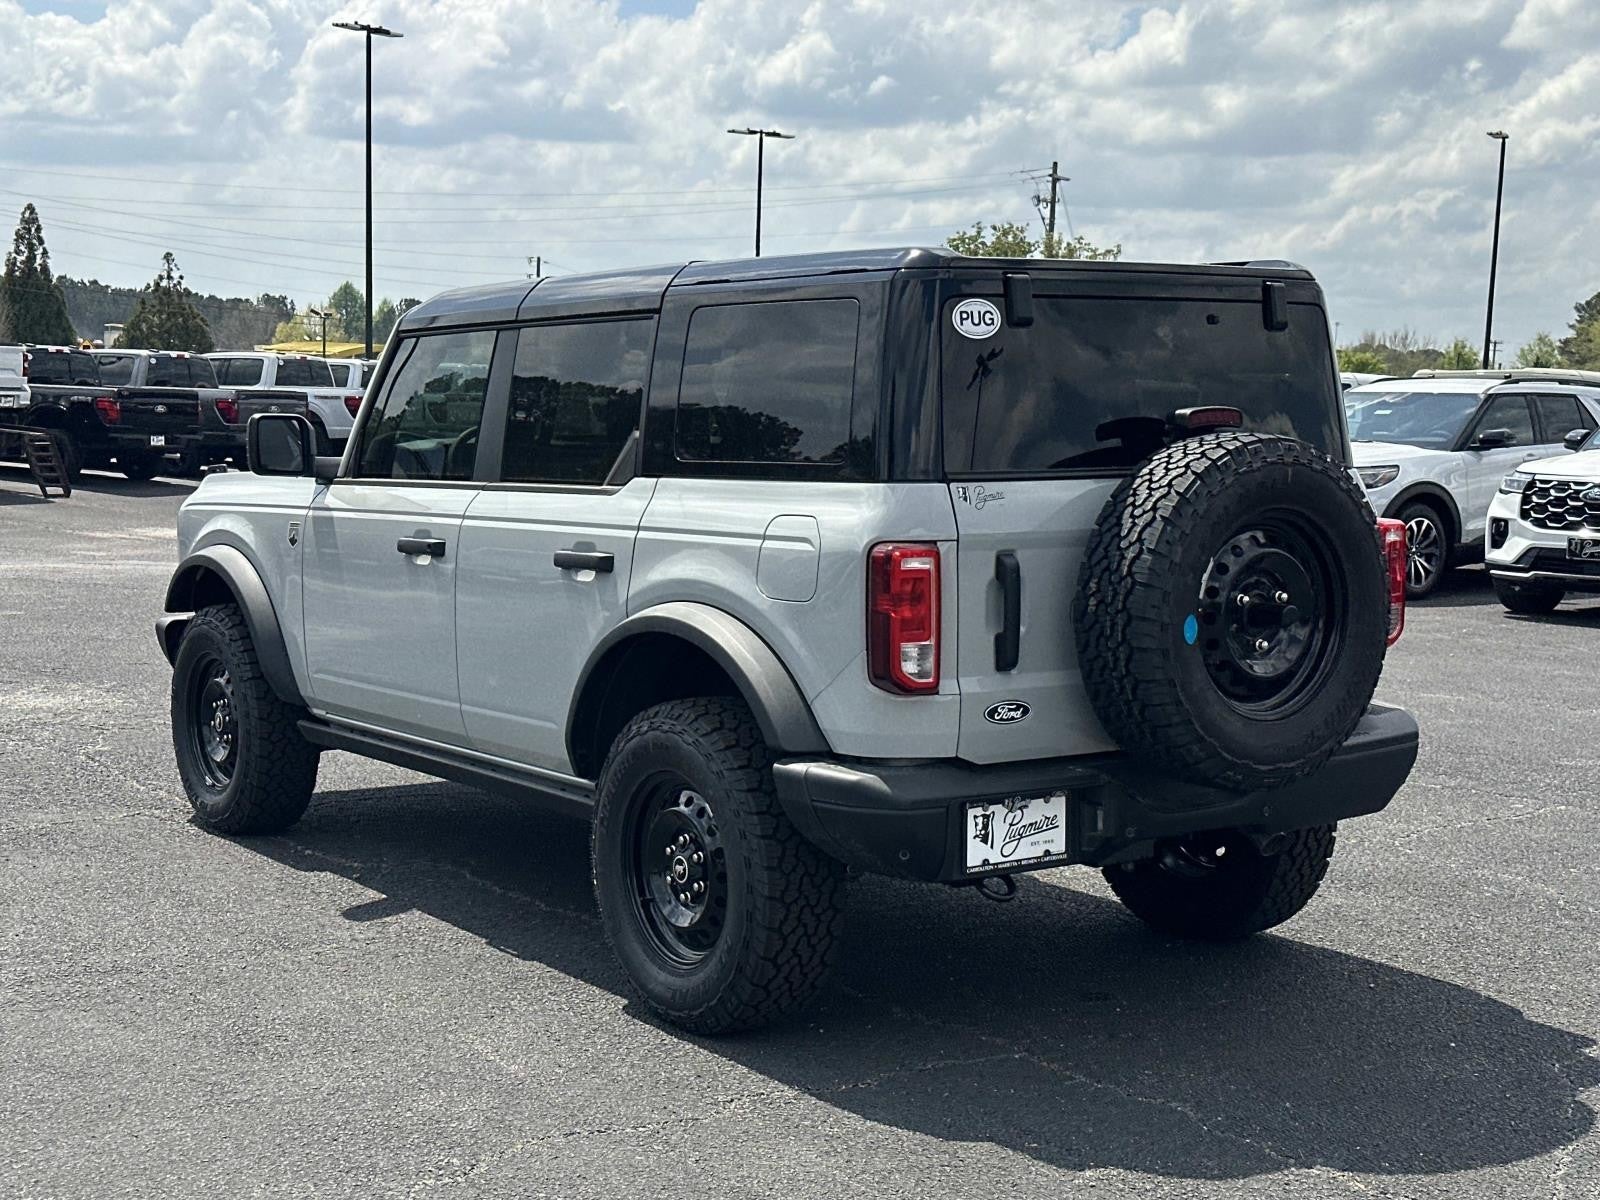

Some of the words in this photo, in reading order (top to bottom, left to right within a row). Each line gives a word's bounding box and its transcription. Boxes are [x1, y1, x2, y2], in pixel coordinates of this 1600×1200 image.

[959, 310, 995, 326] PUG
[994, 704, 1024, 720] Ford
[1000, 804, 1060, 858] Pugmire
